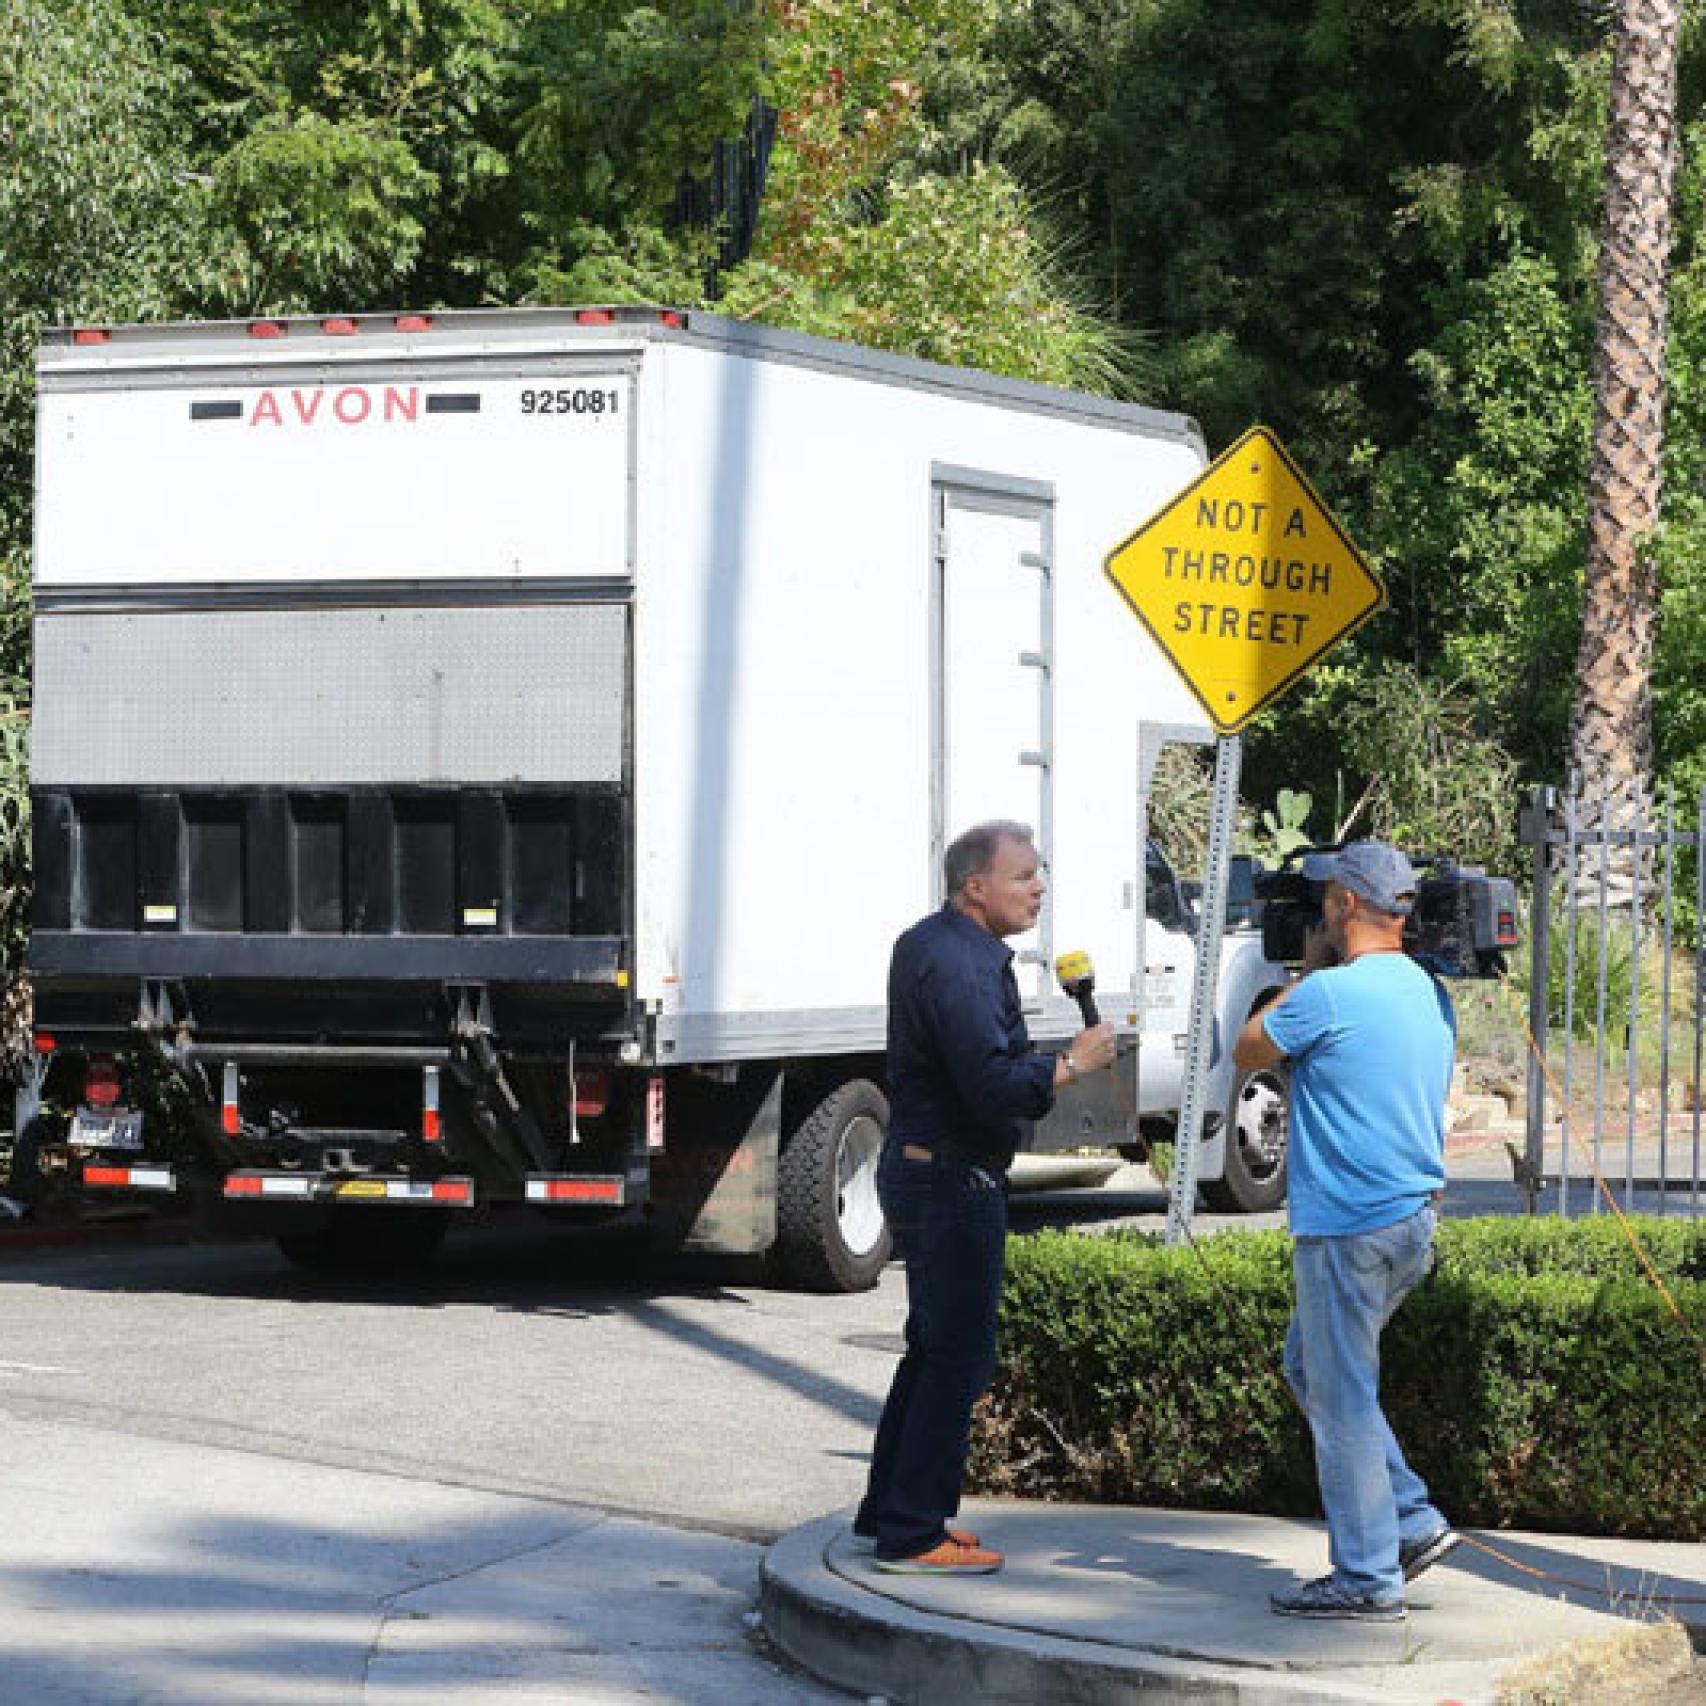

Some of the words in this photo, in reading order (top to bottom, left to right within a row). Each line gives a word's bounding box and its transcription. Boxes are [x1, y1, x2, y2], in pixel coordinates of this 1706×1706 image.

[250, 387, 418, 426] AVON
[520, 389, 618, 414] 925081
[1196, 499, 1268, 535] NOT
[1283, 507, 1307, 538] A
[1162, 547, 1332, 596] THROUGH
[1174, 601, 1310, 645] STREET
